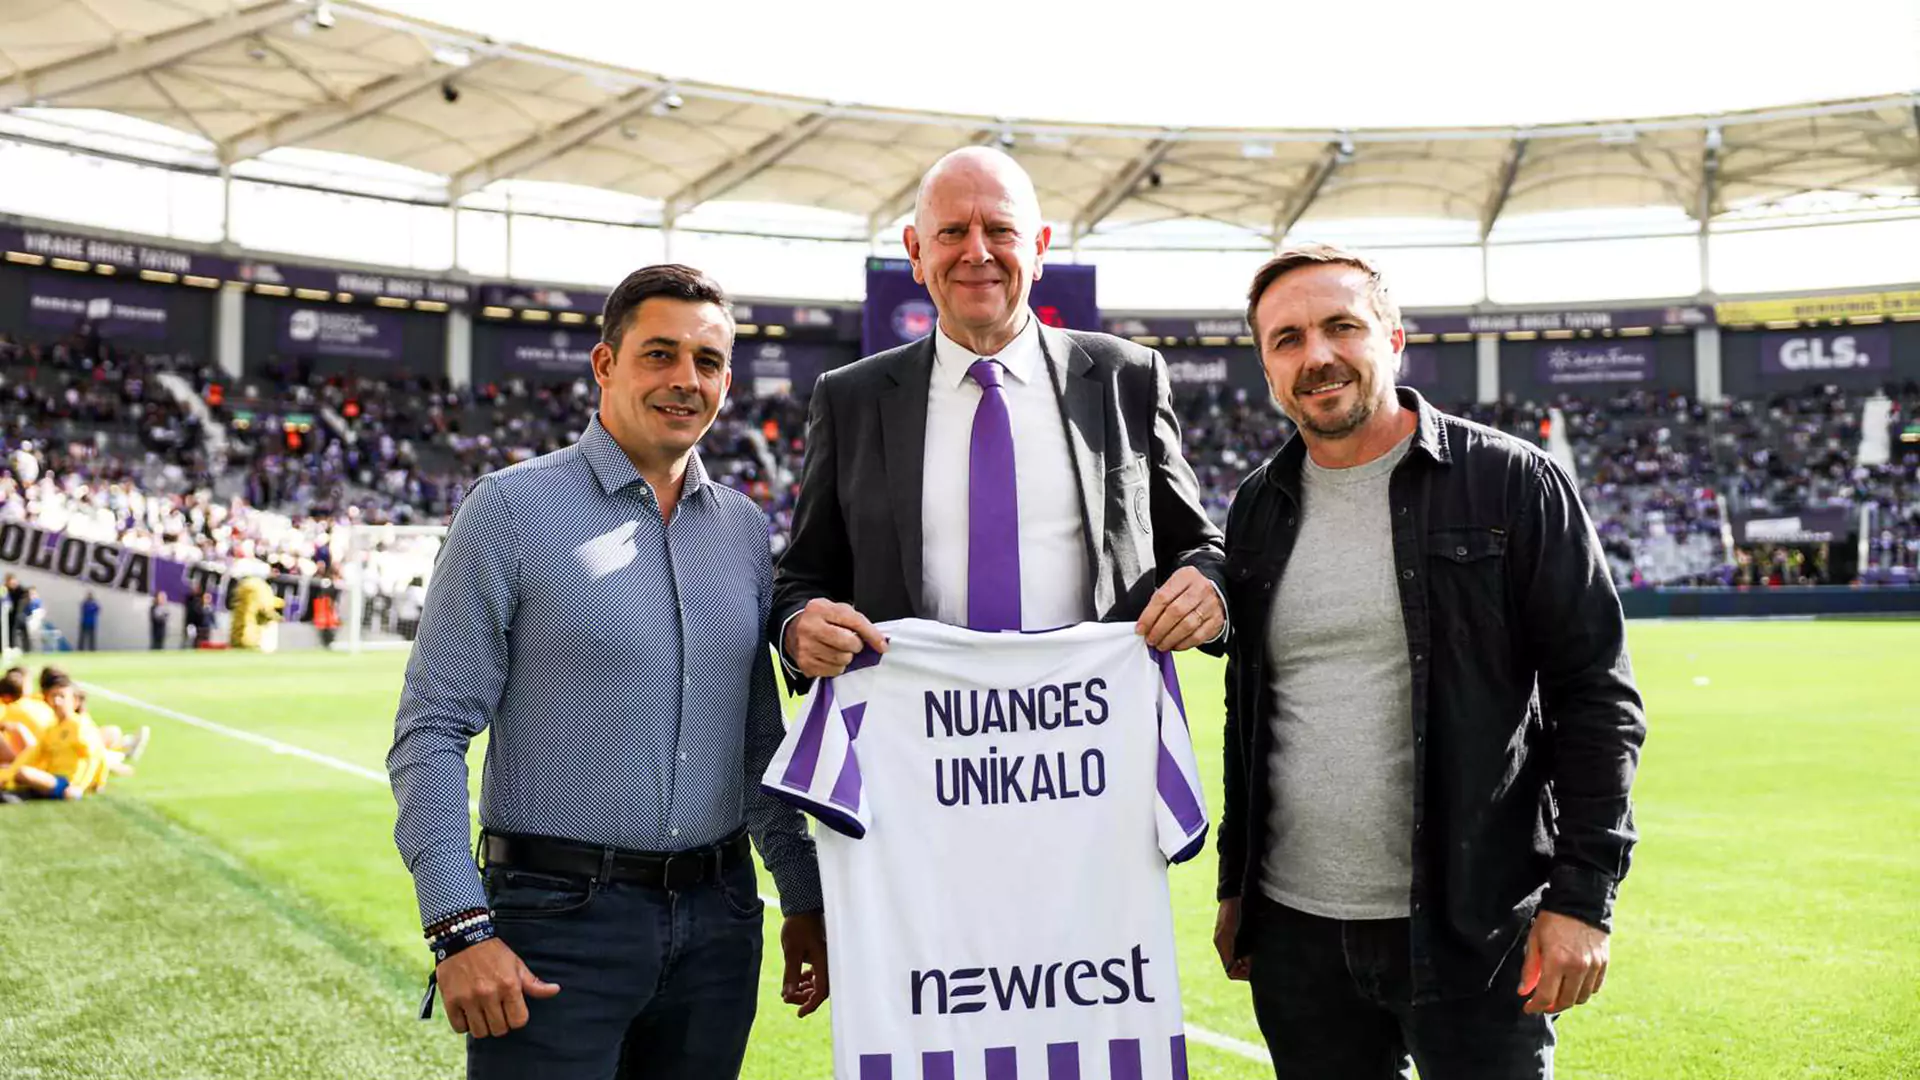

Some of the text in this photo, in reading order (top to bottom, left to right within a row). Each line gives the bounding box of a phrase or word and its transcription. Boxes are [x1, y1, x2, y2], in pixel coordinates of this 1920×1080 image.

[1779, 336, 1870, 370] GLS.
[925, 678, 1108, 737] NUANCES
[912, 944, 1155, 1014] newrest
